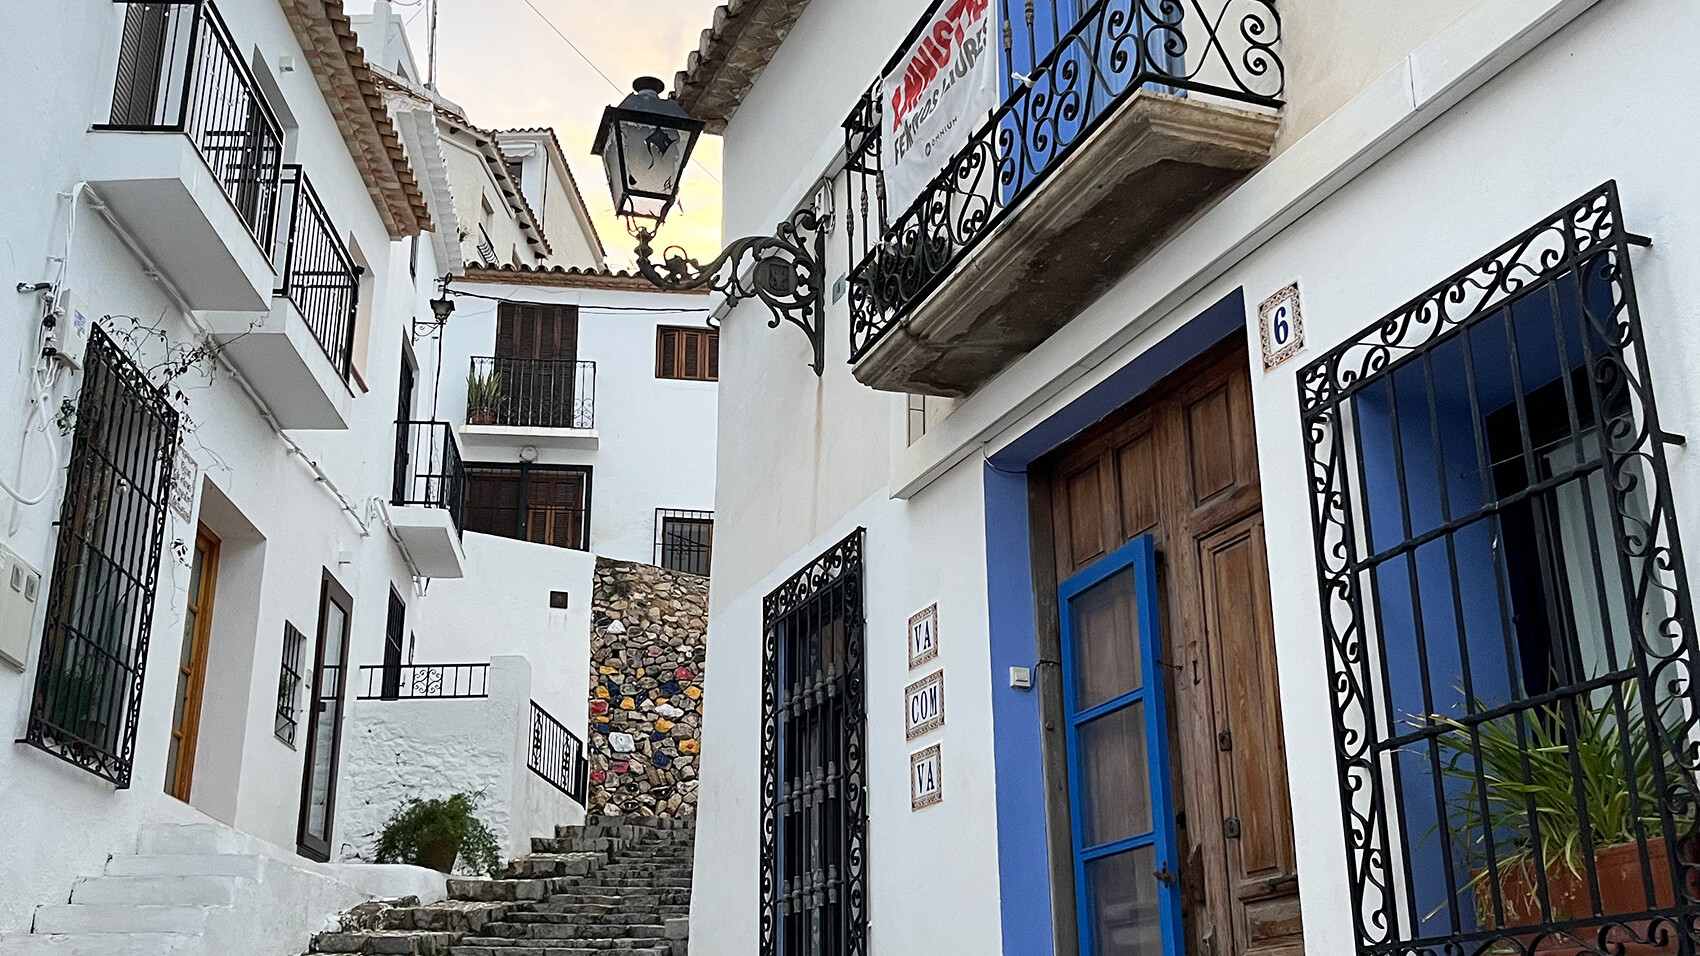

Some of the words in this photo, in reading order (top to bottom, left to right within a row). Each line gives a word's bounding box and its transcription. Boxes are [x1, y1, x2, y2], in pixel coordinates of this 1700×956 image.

[1274, 306, 1289, 345] 6
[914, 620, 932, 654] VA
[911, 685, 938, 724] COM
[916, 760, 935, 794] VA
